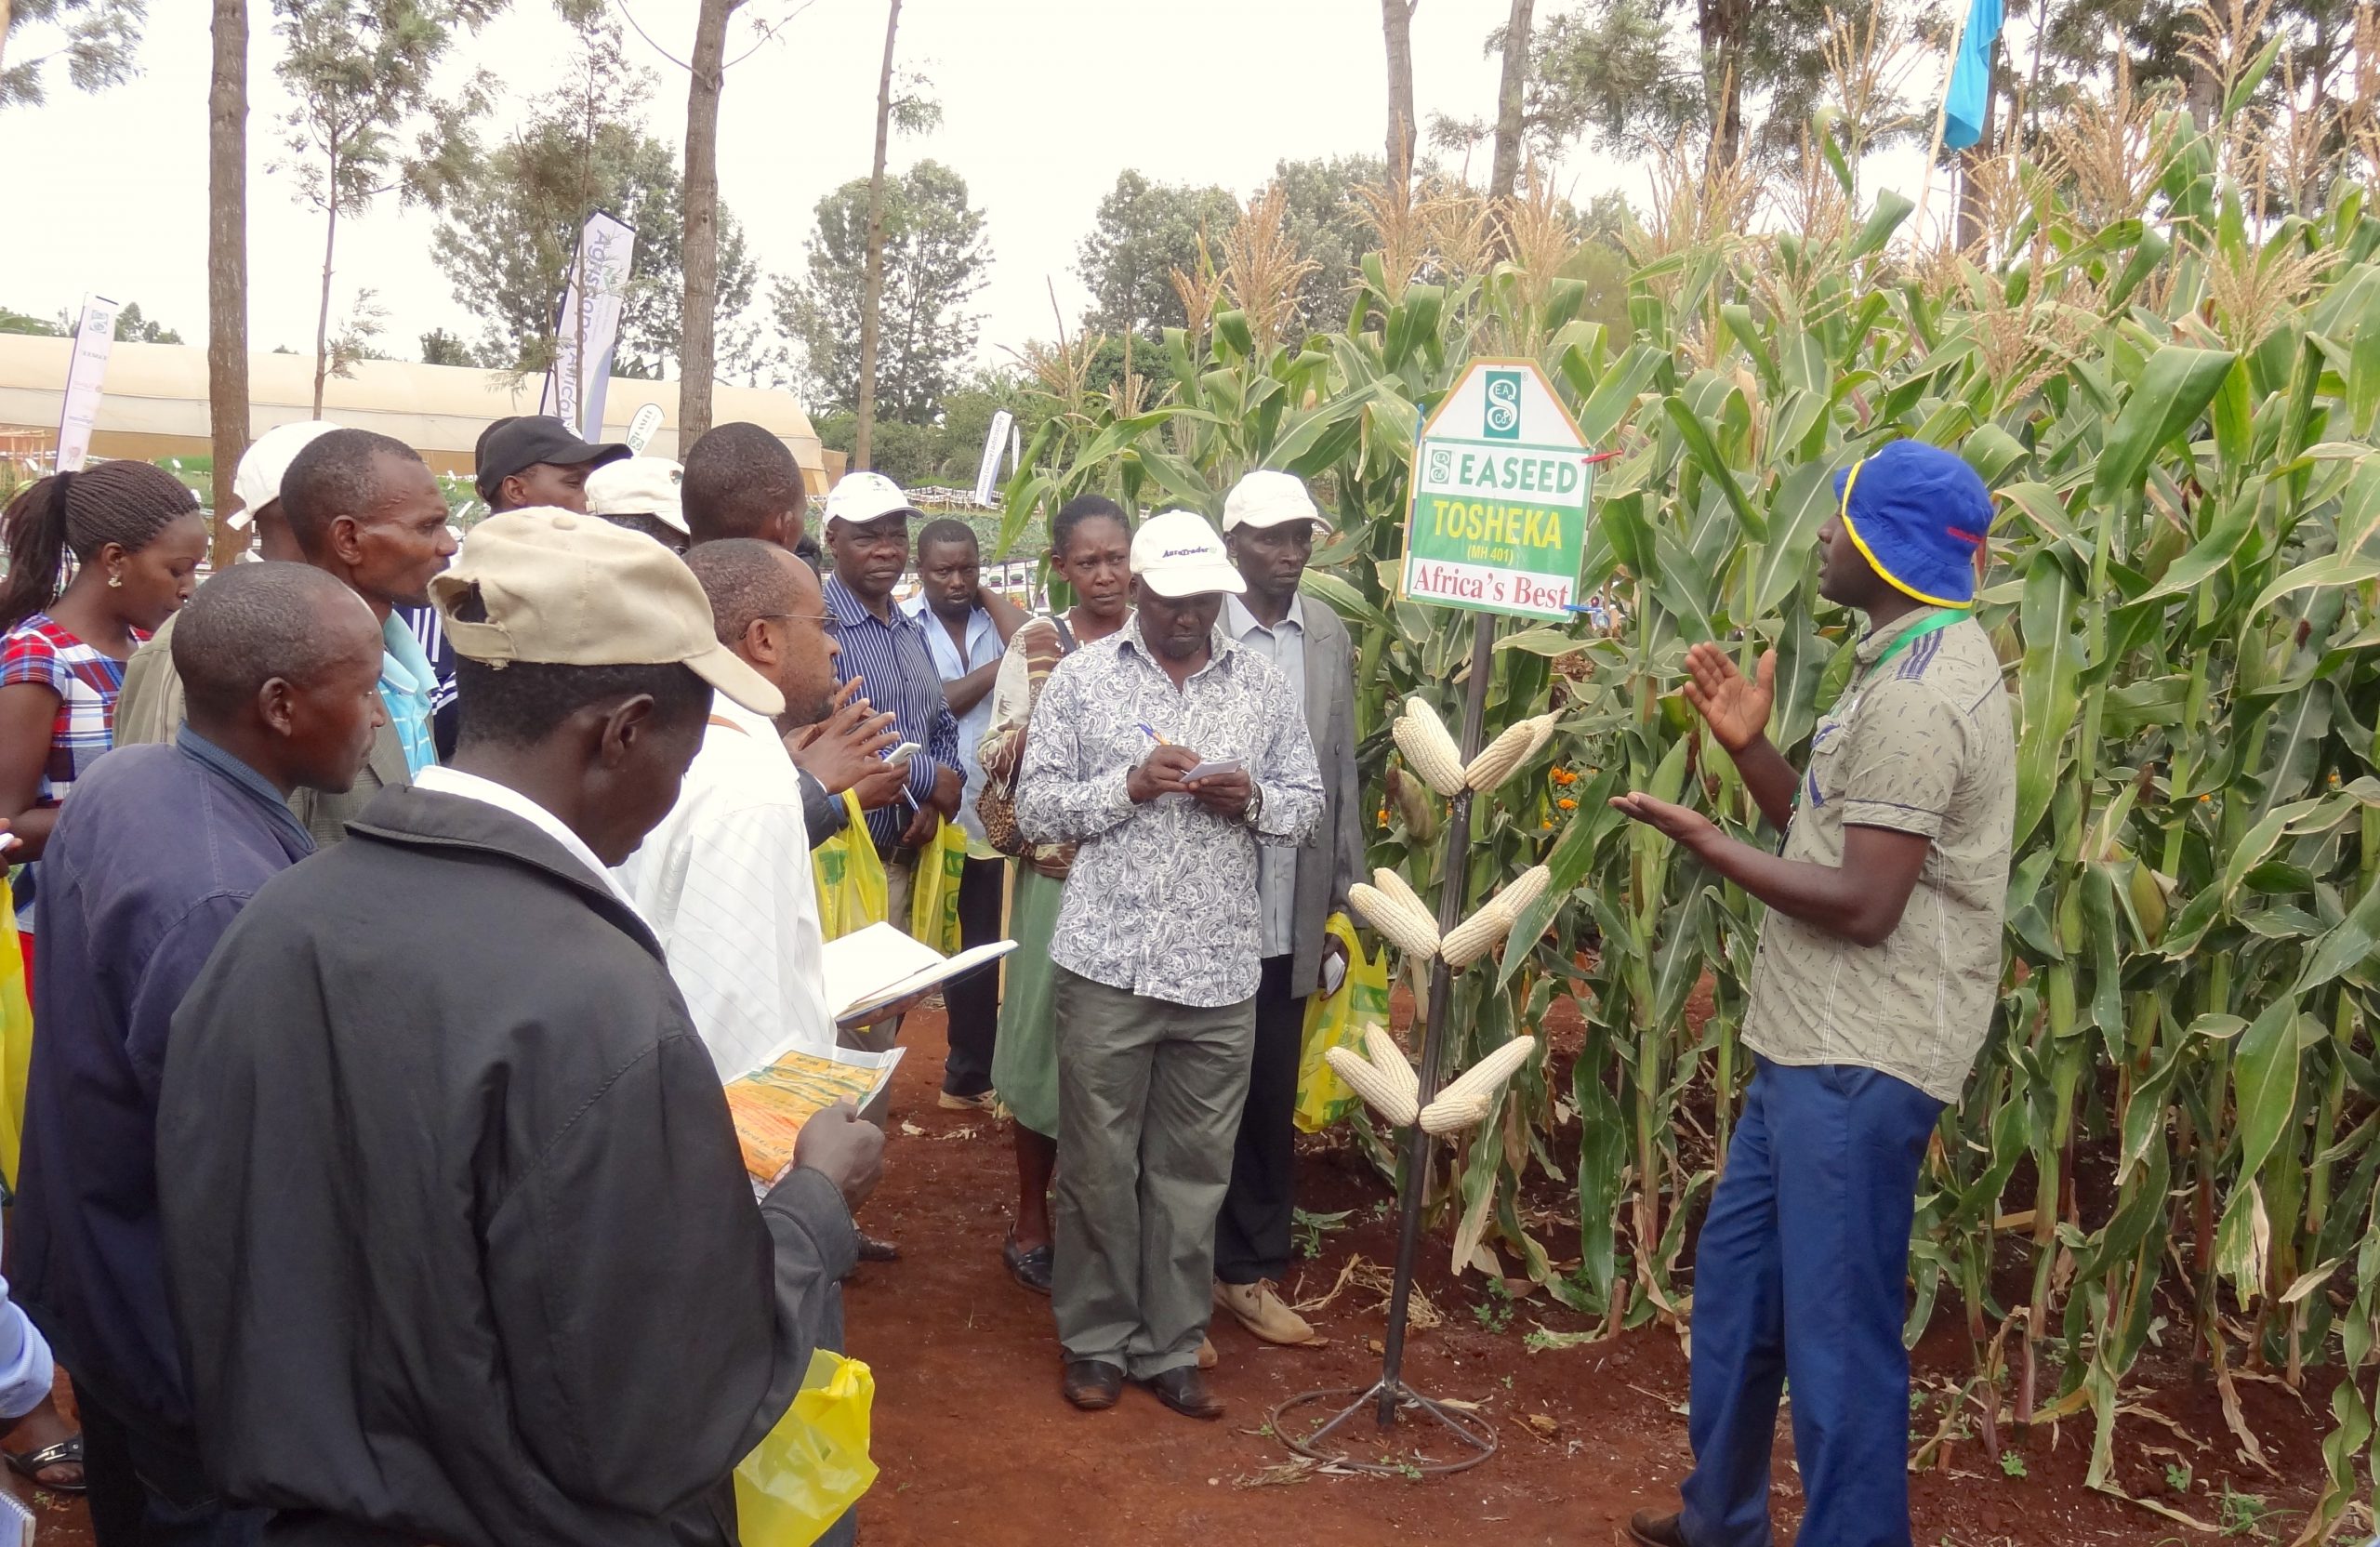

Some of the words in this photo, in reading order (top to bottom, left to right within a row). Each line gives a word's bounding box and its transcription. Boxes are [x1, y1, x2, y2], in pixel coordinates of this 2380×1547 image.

[574, 229, 611, 343] Agrisope
[1433, 500, 1562, 549] TOSHEKA
[1467, 545, 1488, 561] (MH
[1490, 547, 1514, 566] 401)
[1512, 575, 1568, 610] Best
